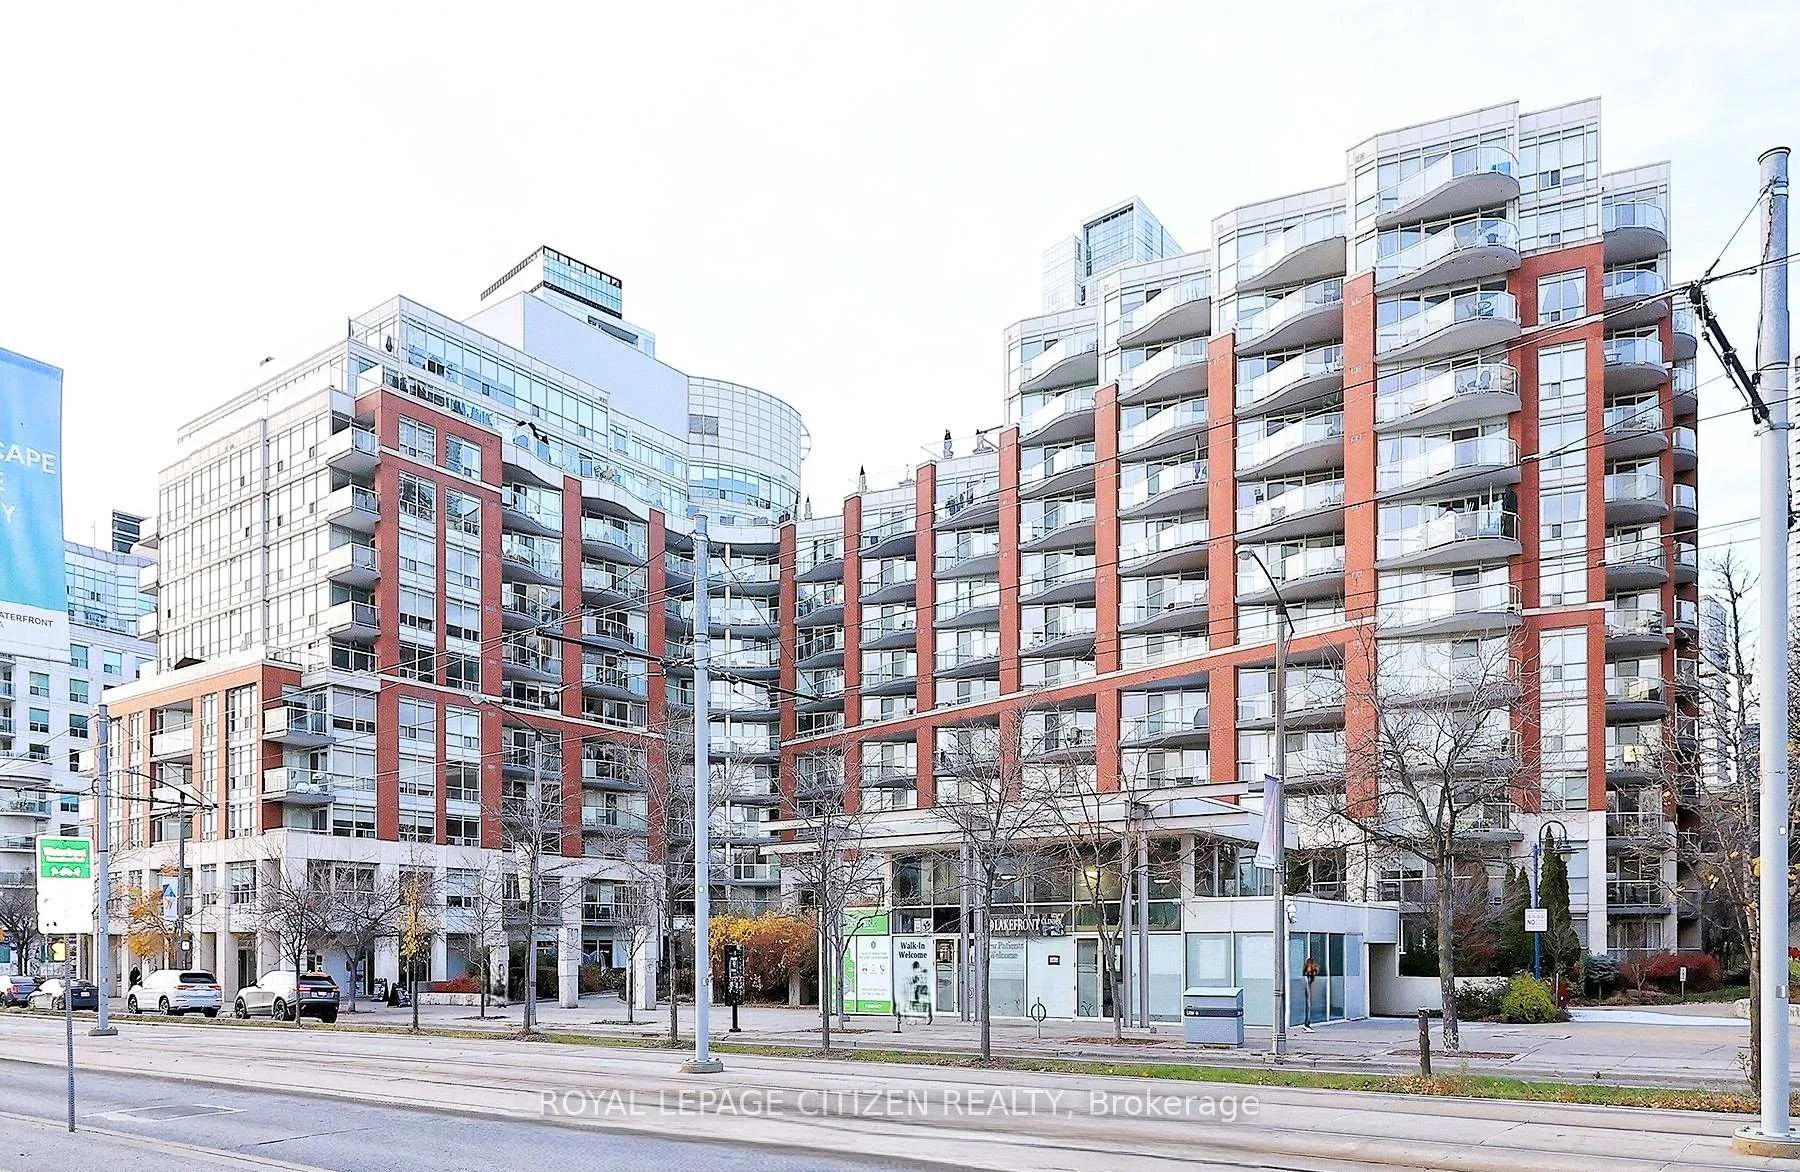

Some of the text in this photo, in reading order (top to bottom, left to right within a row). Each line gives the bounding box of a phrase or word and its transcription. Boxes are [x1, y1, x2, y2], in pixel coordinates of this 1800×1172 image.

[994, 918, 1040, 931] LAKEFRONT
[900, 941, 926, 949] Walk-In
[898, 951, 928, 959] Welcome
